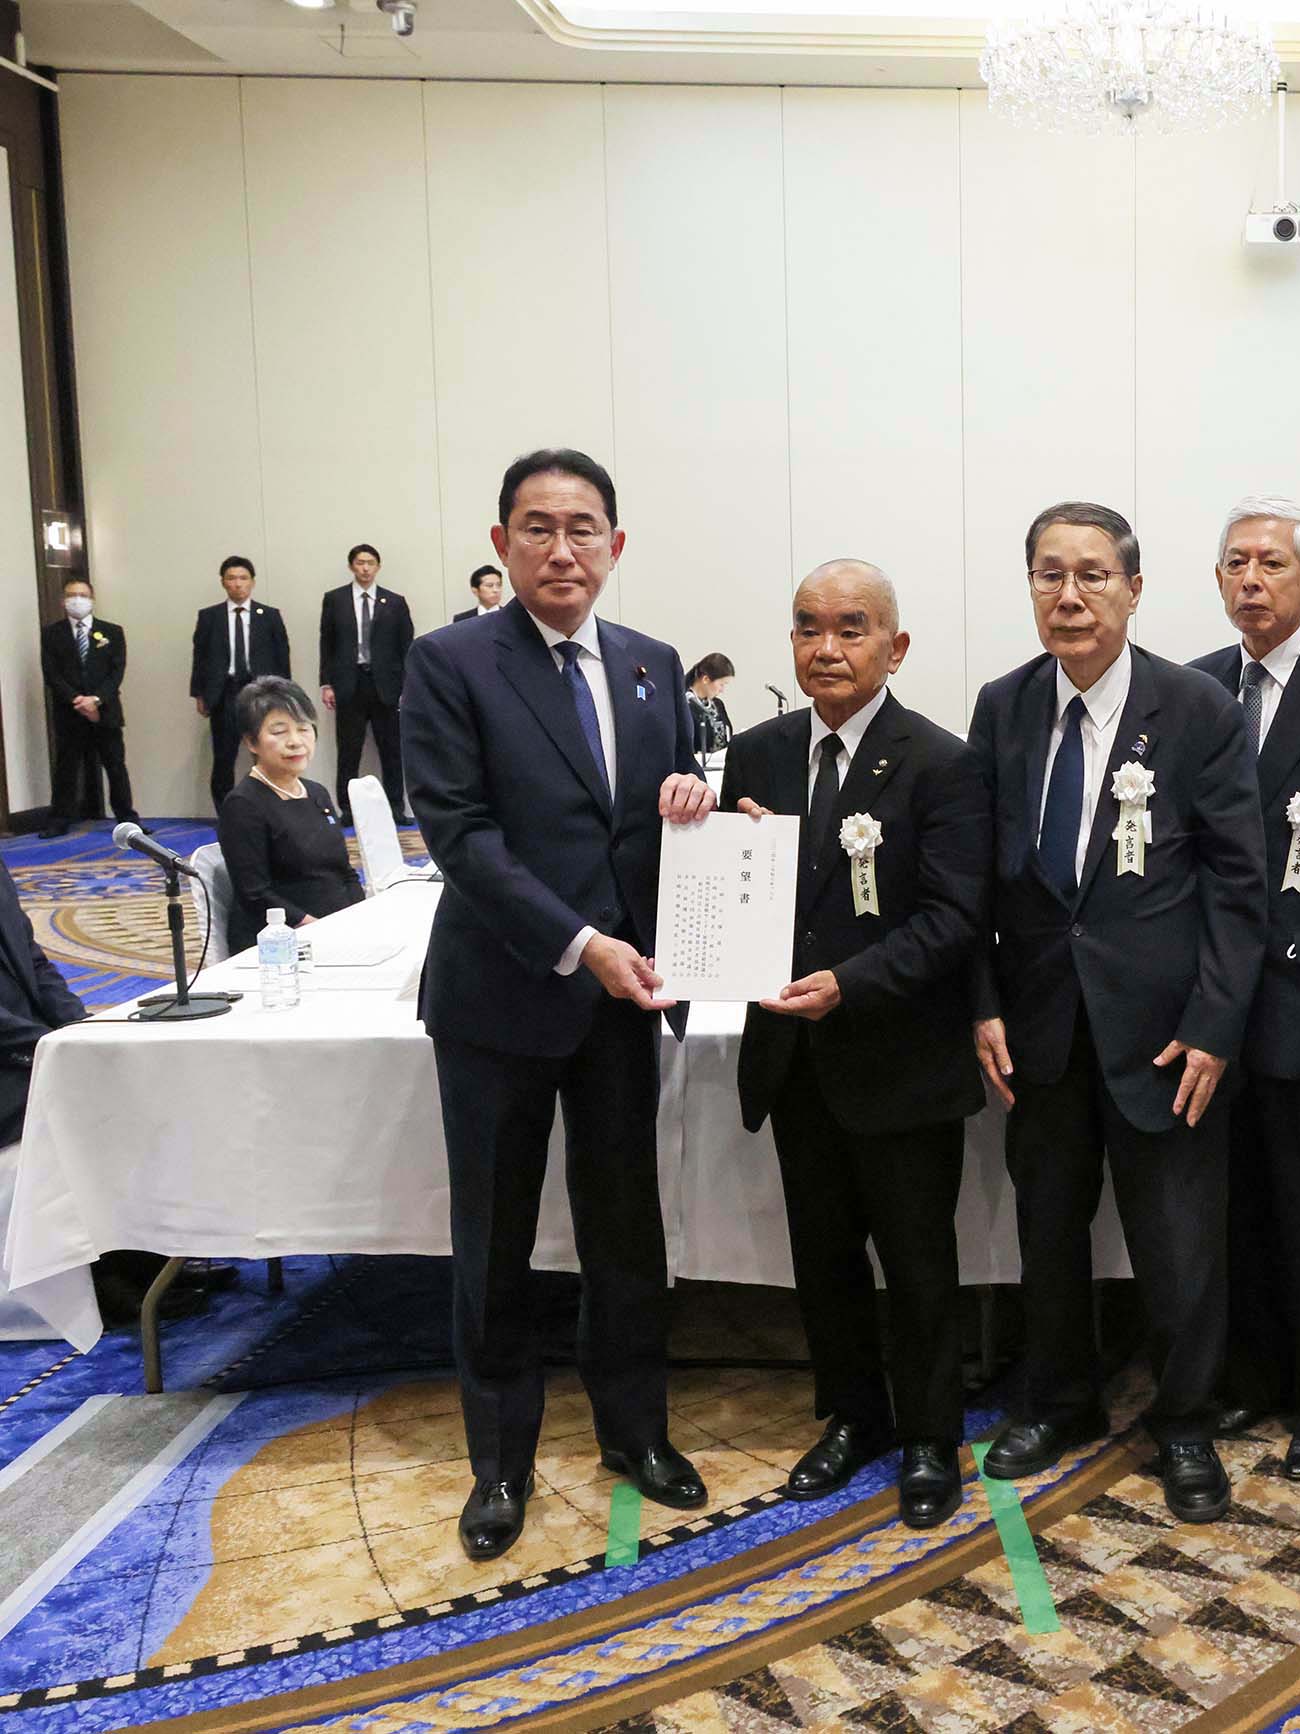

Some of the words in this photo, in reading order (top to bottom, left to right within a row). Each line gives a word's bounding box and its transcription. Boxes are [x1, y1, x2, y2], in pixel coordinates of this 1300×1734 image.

[1124, 819, 1137, 863] 発言者
[739, 849, 753, 904] 要望書
[858, 857, 871, 901] 発言者
